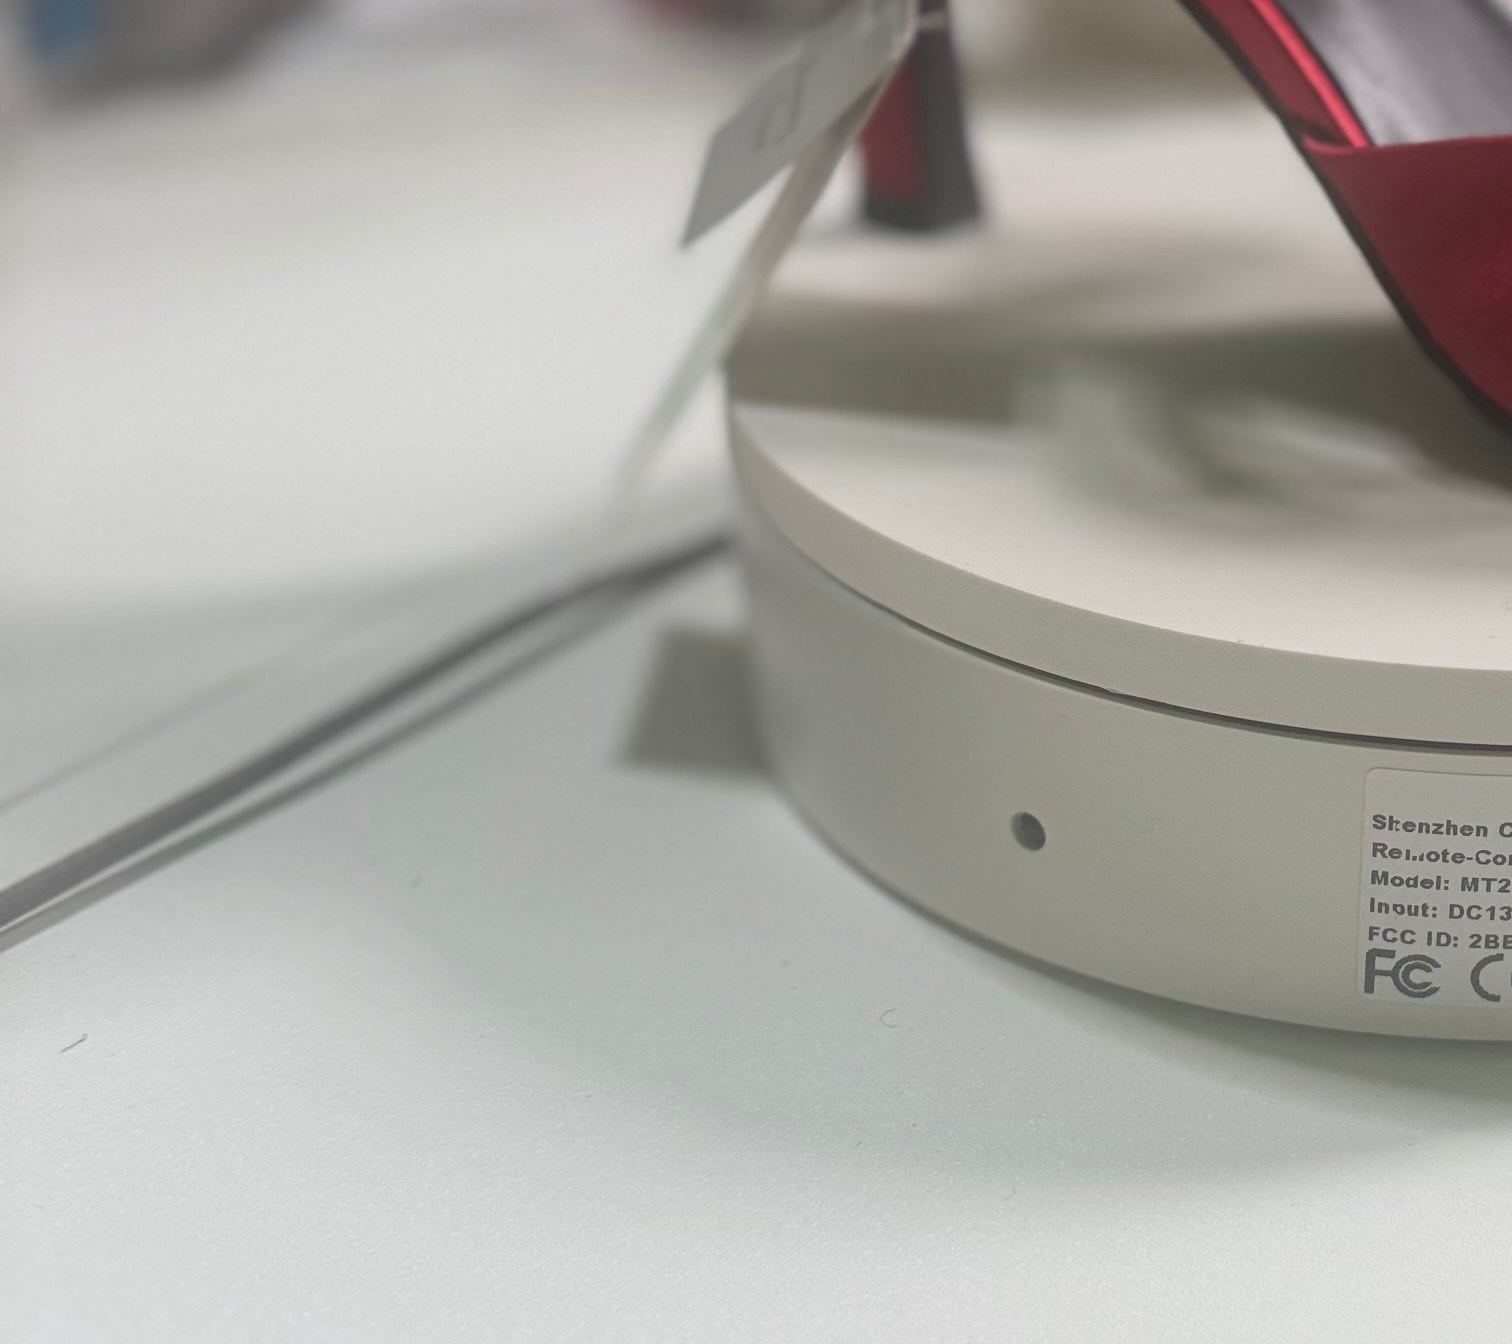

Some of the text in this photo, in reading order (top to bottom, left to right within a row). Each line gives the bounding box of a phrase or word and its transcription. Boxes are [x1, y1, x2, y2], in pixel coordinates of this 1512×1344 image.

[1371, 813, 1489, 838] Shenzhen
[1370, 869, 1450, 891] Model:
[1368, 926, 1417, 945] FCC
[1426, 931, 1459, 948] ID:
